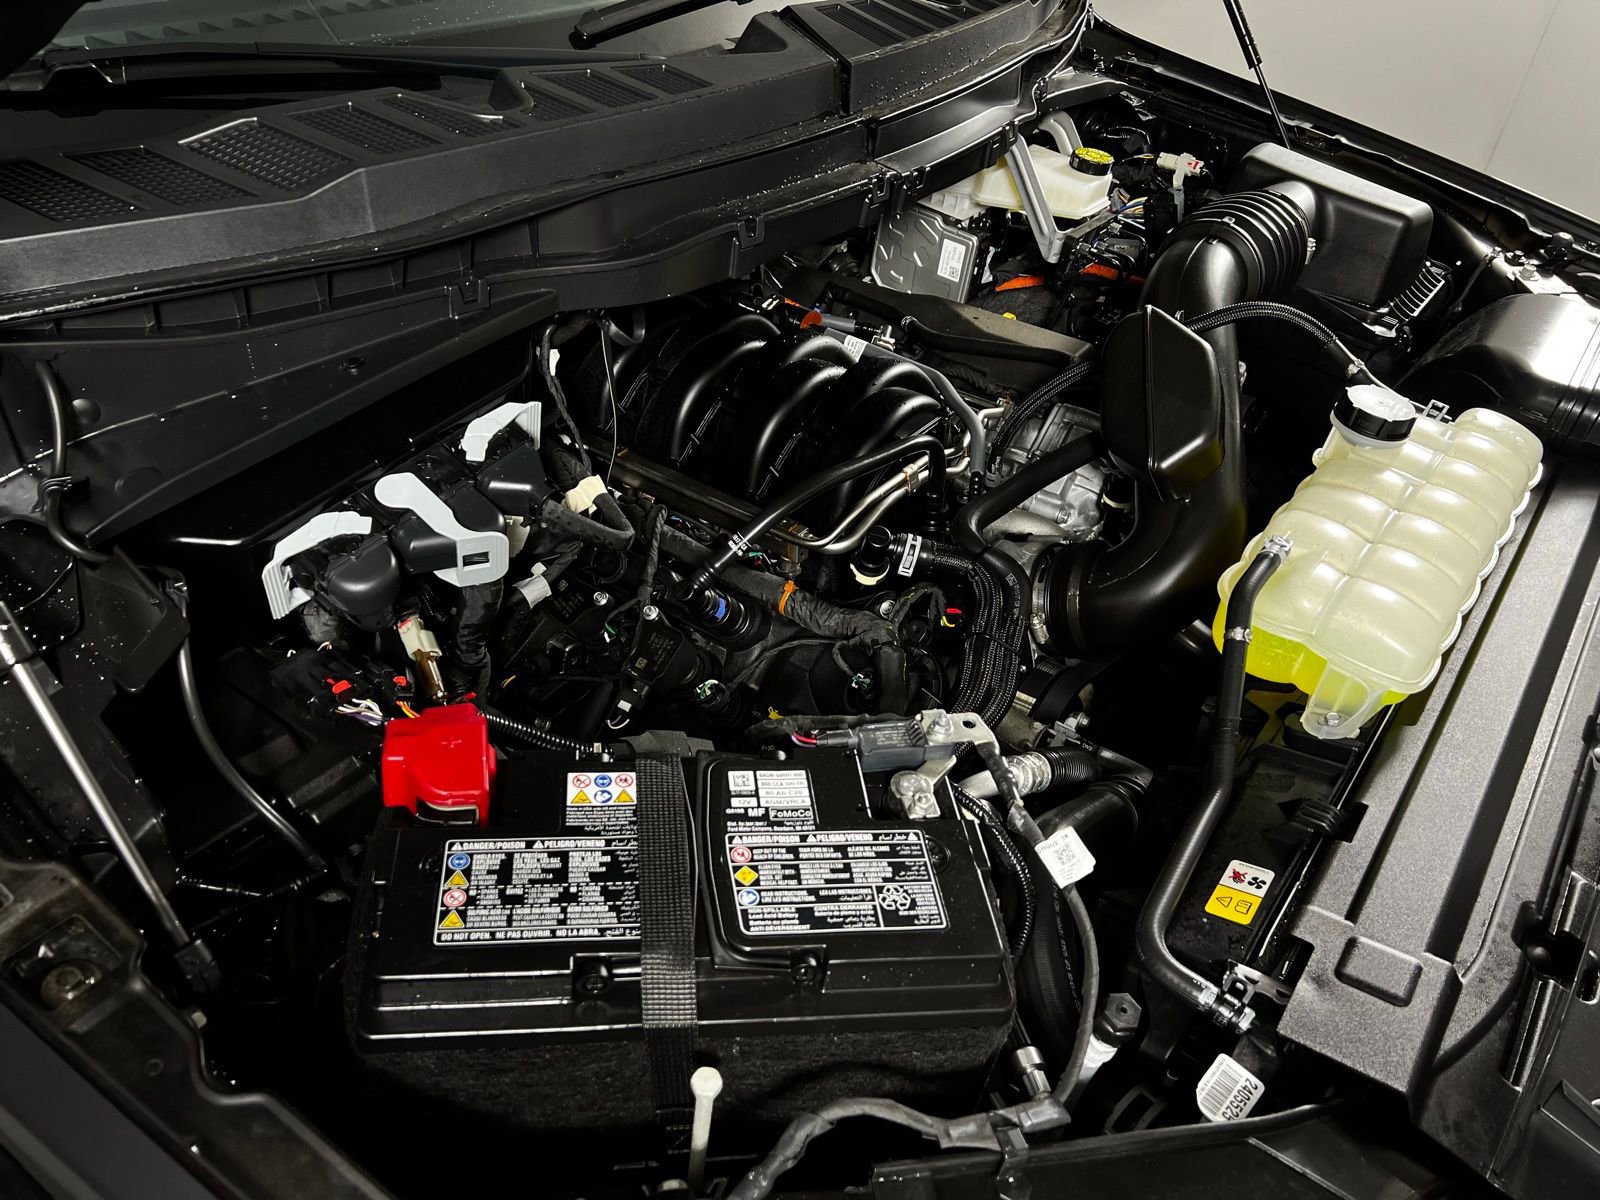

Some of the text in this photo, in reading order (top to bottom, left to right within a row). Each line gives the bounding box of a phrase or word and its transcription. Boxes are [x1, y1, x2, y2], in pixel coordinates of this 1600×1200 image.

[747, 807, 766, 817] MF
[770, 809, 811, 818] FoMoCo
[742, 835, 800, 843] DANGER/POISON
[817, 833, 873, 841] PELIGRO/VENENO
[462, 841, 525, 849] DANGER/POISON
[543, 839, 606, 848] PELIGRO/VENENO
[453, 932, 468, 940] NOT
[469, 931, 492, 939] OPEN.
[495, 930, 552, 939] NE PAS OUVRIR.
[567, 928, 577, 936] LA
[578, 928, 600, 936] ABRA.
